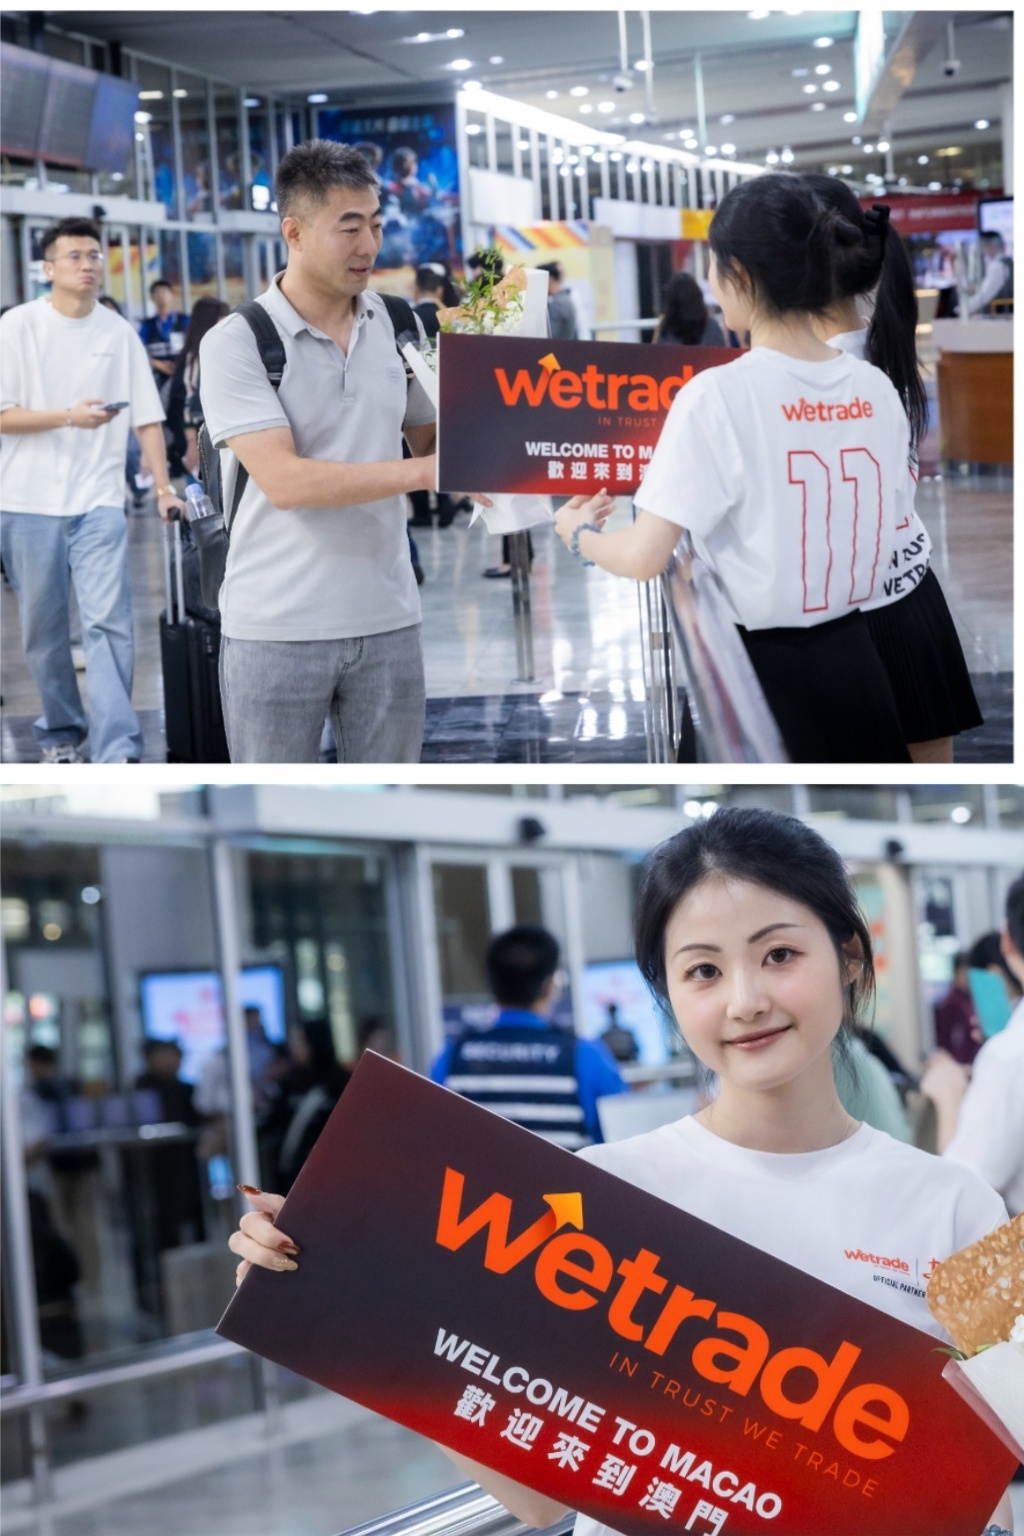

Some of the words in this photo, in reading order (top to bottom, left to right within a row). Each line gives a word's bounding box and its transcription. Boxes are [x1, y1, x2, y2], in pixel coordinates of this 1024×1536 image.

[494, 353, 693, 411] wetrad
[598, 416, 611, 426] IN
[617, 416, 657, 427] TRUST
[781, 397, 873, 421] wetrade
[525, 442, 609, 459] WELCOME
[612, 444, 635, 460] TO
[844, 1248, 910, 1272] wetrade
[873, 1275, 899, 1289] OFFICIAL
[900, 1283, 926, 1298] PARTNER
[435, 1167, 910, 1460] wetrade
[433, 1328, 606, 1433] WELCOME
[612, 1416, 656, 1457] TO
[660, 1444, 782, 1520] MACAO
[609, 1352, 639, 1379] IN
[650, 1371, 734, 1425] TRUST
[743, 1417, 783, 1450] WE
[793, 1443, 880, 1498] TRADE
[454, 1385, 729, 1536] 歡迎來到澳門
